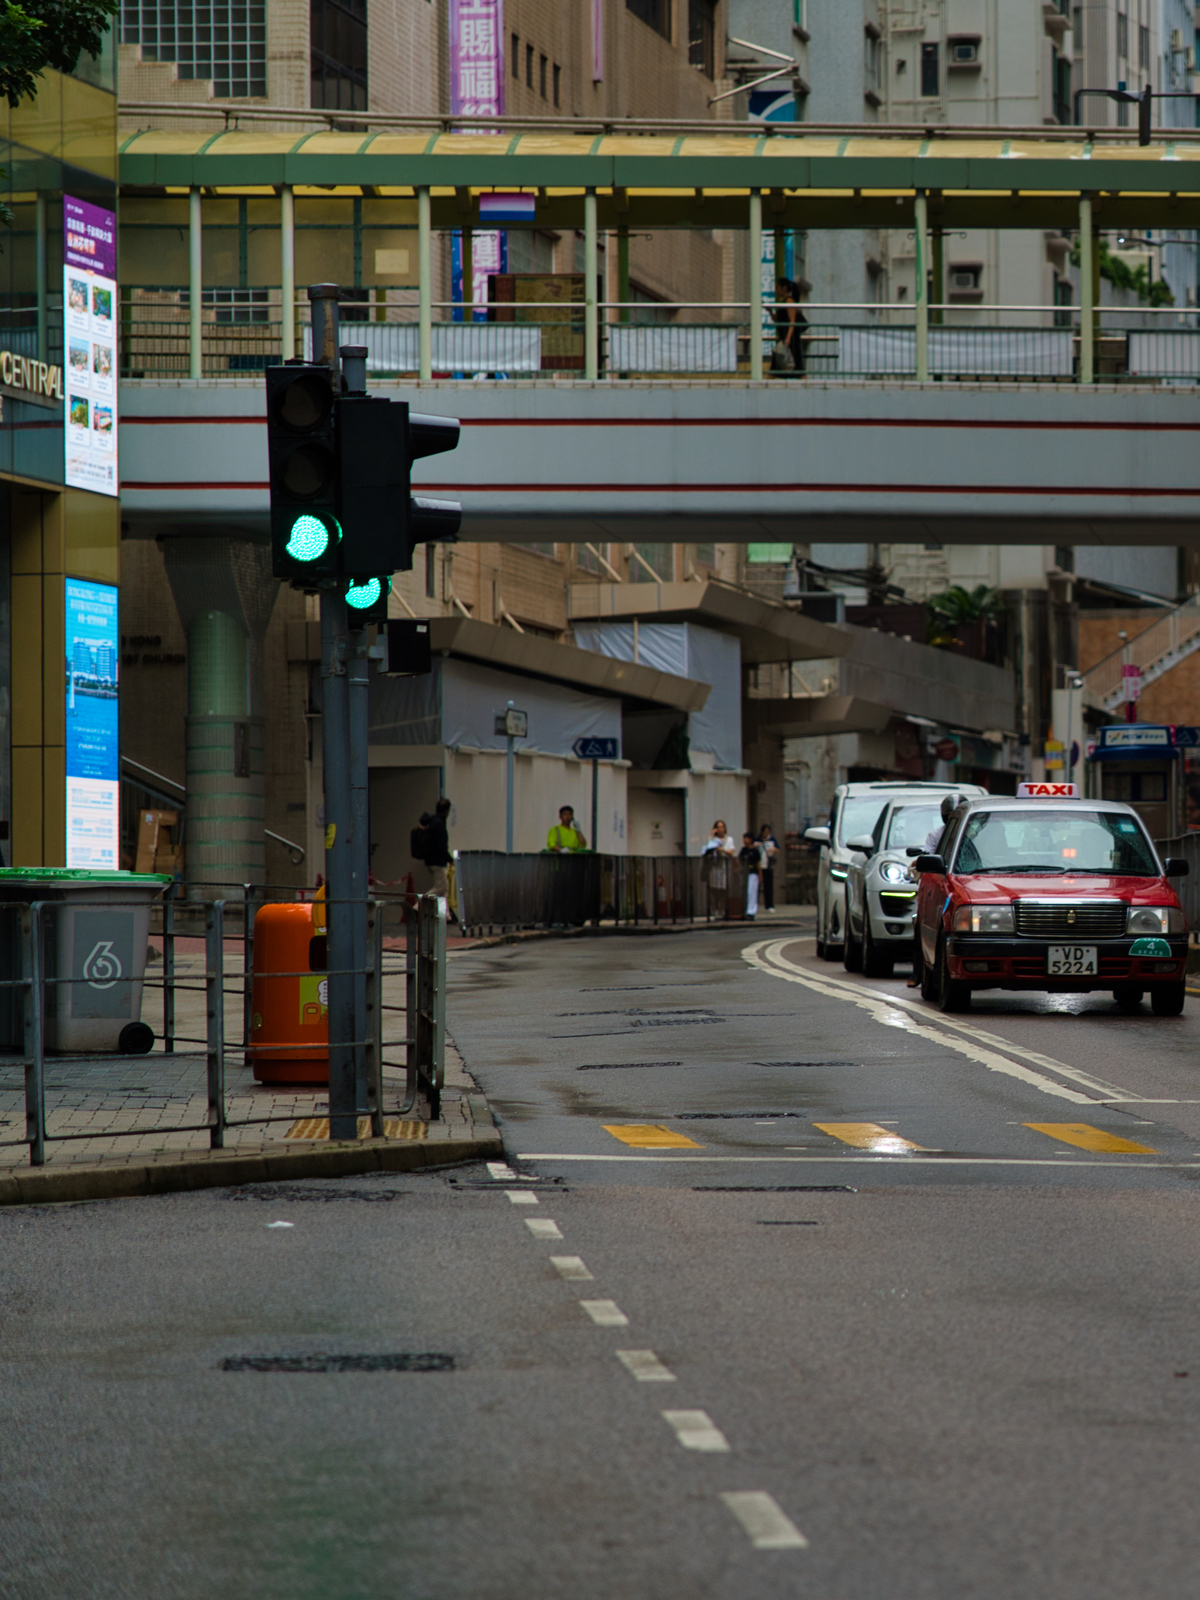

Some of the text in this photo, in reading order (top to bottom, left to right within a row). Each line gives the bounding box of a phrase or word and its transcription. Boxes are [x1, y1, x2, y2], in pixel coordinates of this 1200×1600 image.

[1, 350, 65, 400] CENTRAL
[1024, 784, 1073, 796] TAXI
[1146, 941, 1156, 950] 4
[1062, 948, 1084, 960] VD
[1052, 961, 1094, 974] 5224
